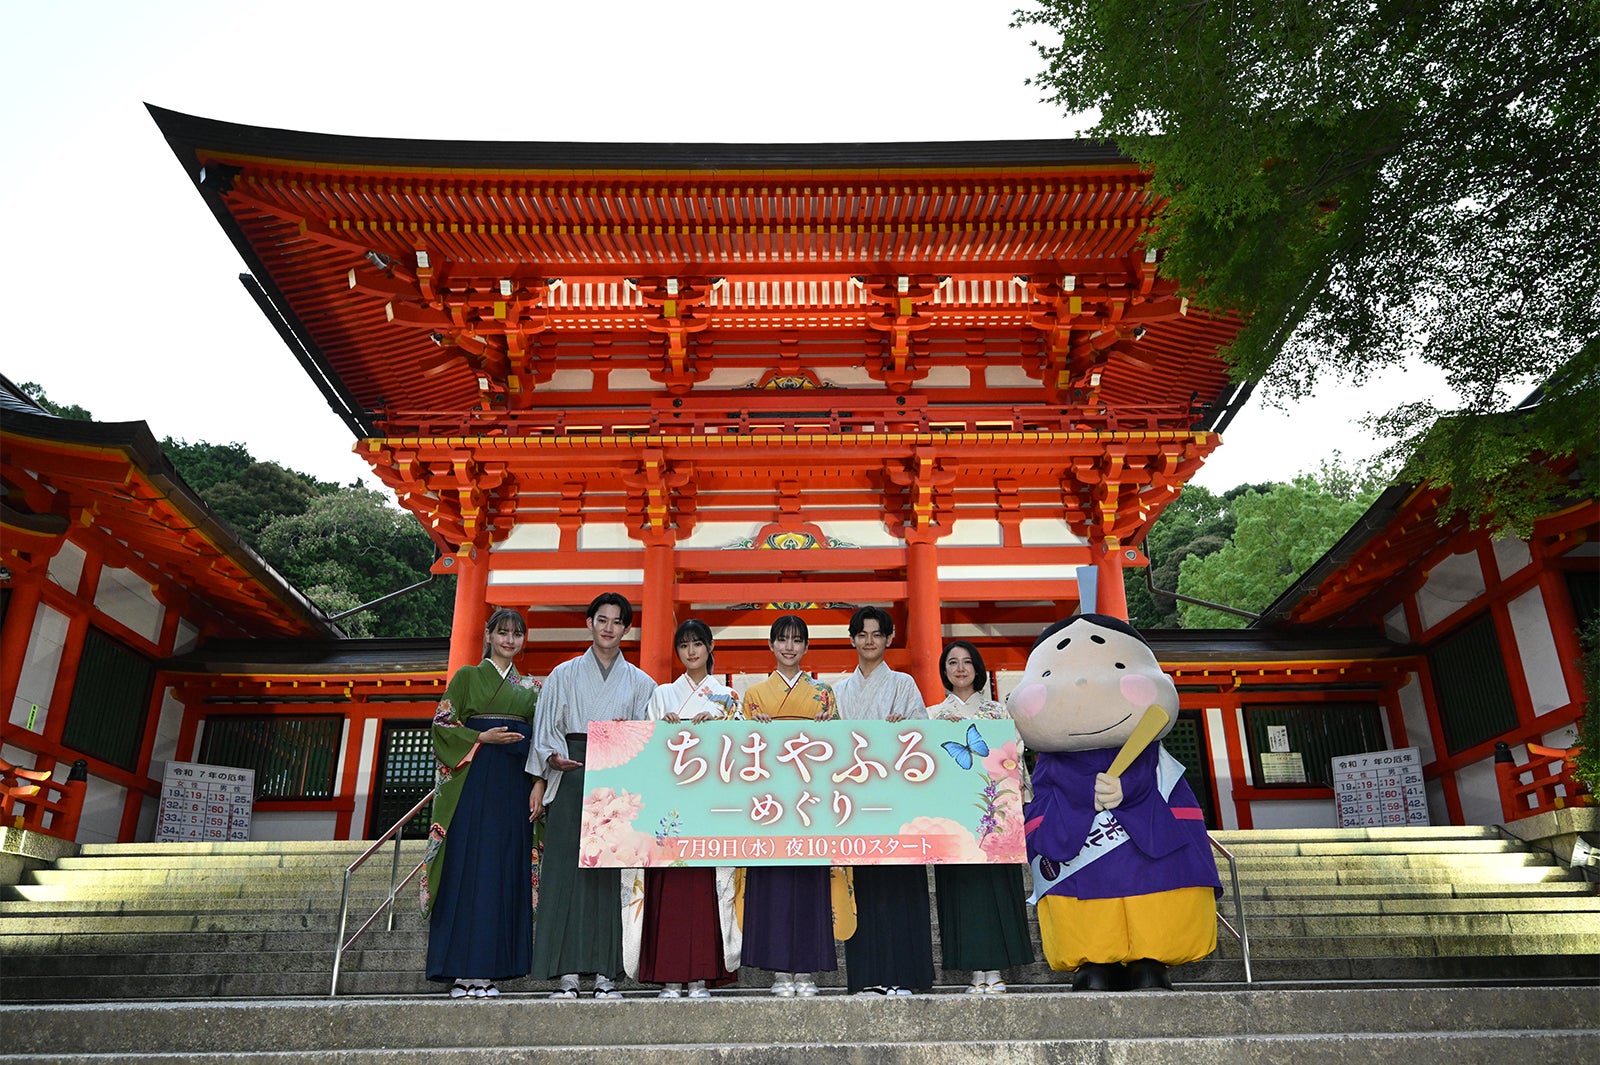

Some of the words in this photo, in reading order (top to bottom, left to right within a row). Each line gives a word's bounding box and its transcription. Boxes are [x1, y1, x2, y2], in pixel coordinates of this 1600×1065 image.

[666, 730, 936, 786] ちはやふる
